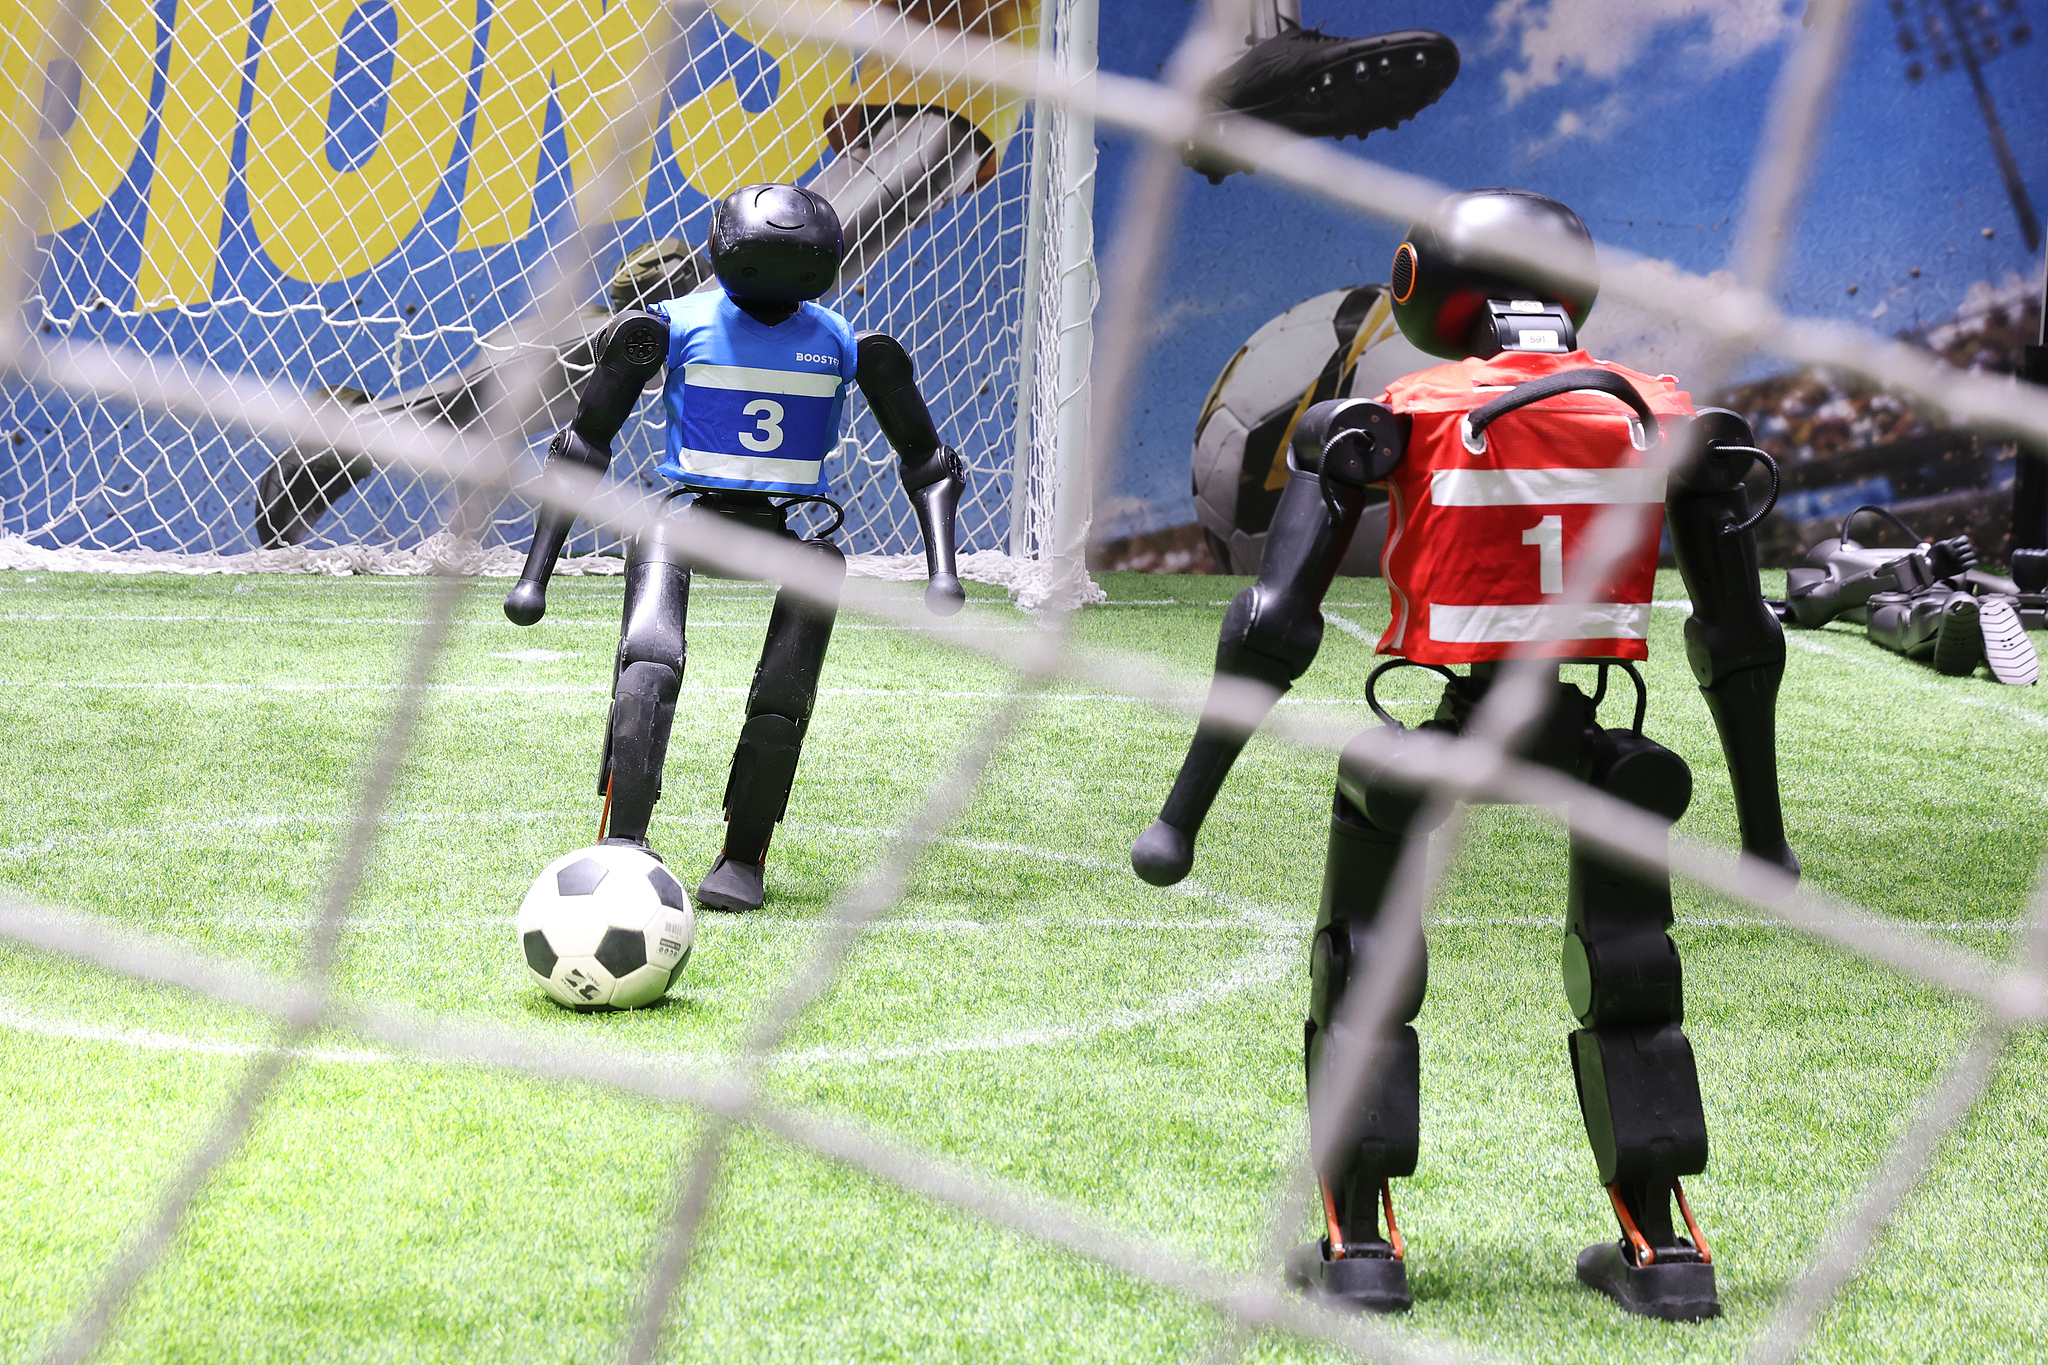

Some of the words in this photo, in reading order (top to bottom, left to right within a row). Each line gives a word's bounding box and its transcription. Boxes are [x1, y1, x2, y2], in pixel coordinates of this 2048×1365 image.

[1529, 335, 1546, 344] 591
[738, 398, 785, 452] 3
[1522, 514, 1563, 594] 1
